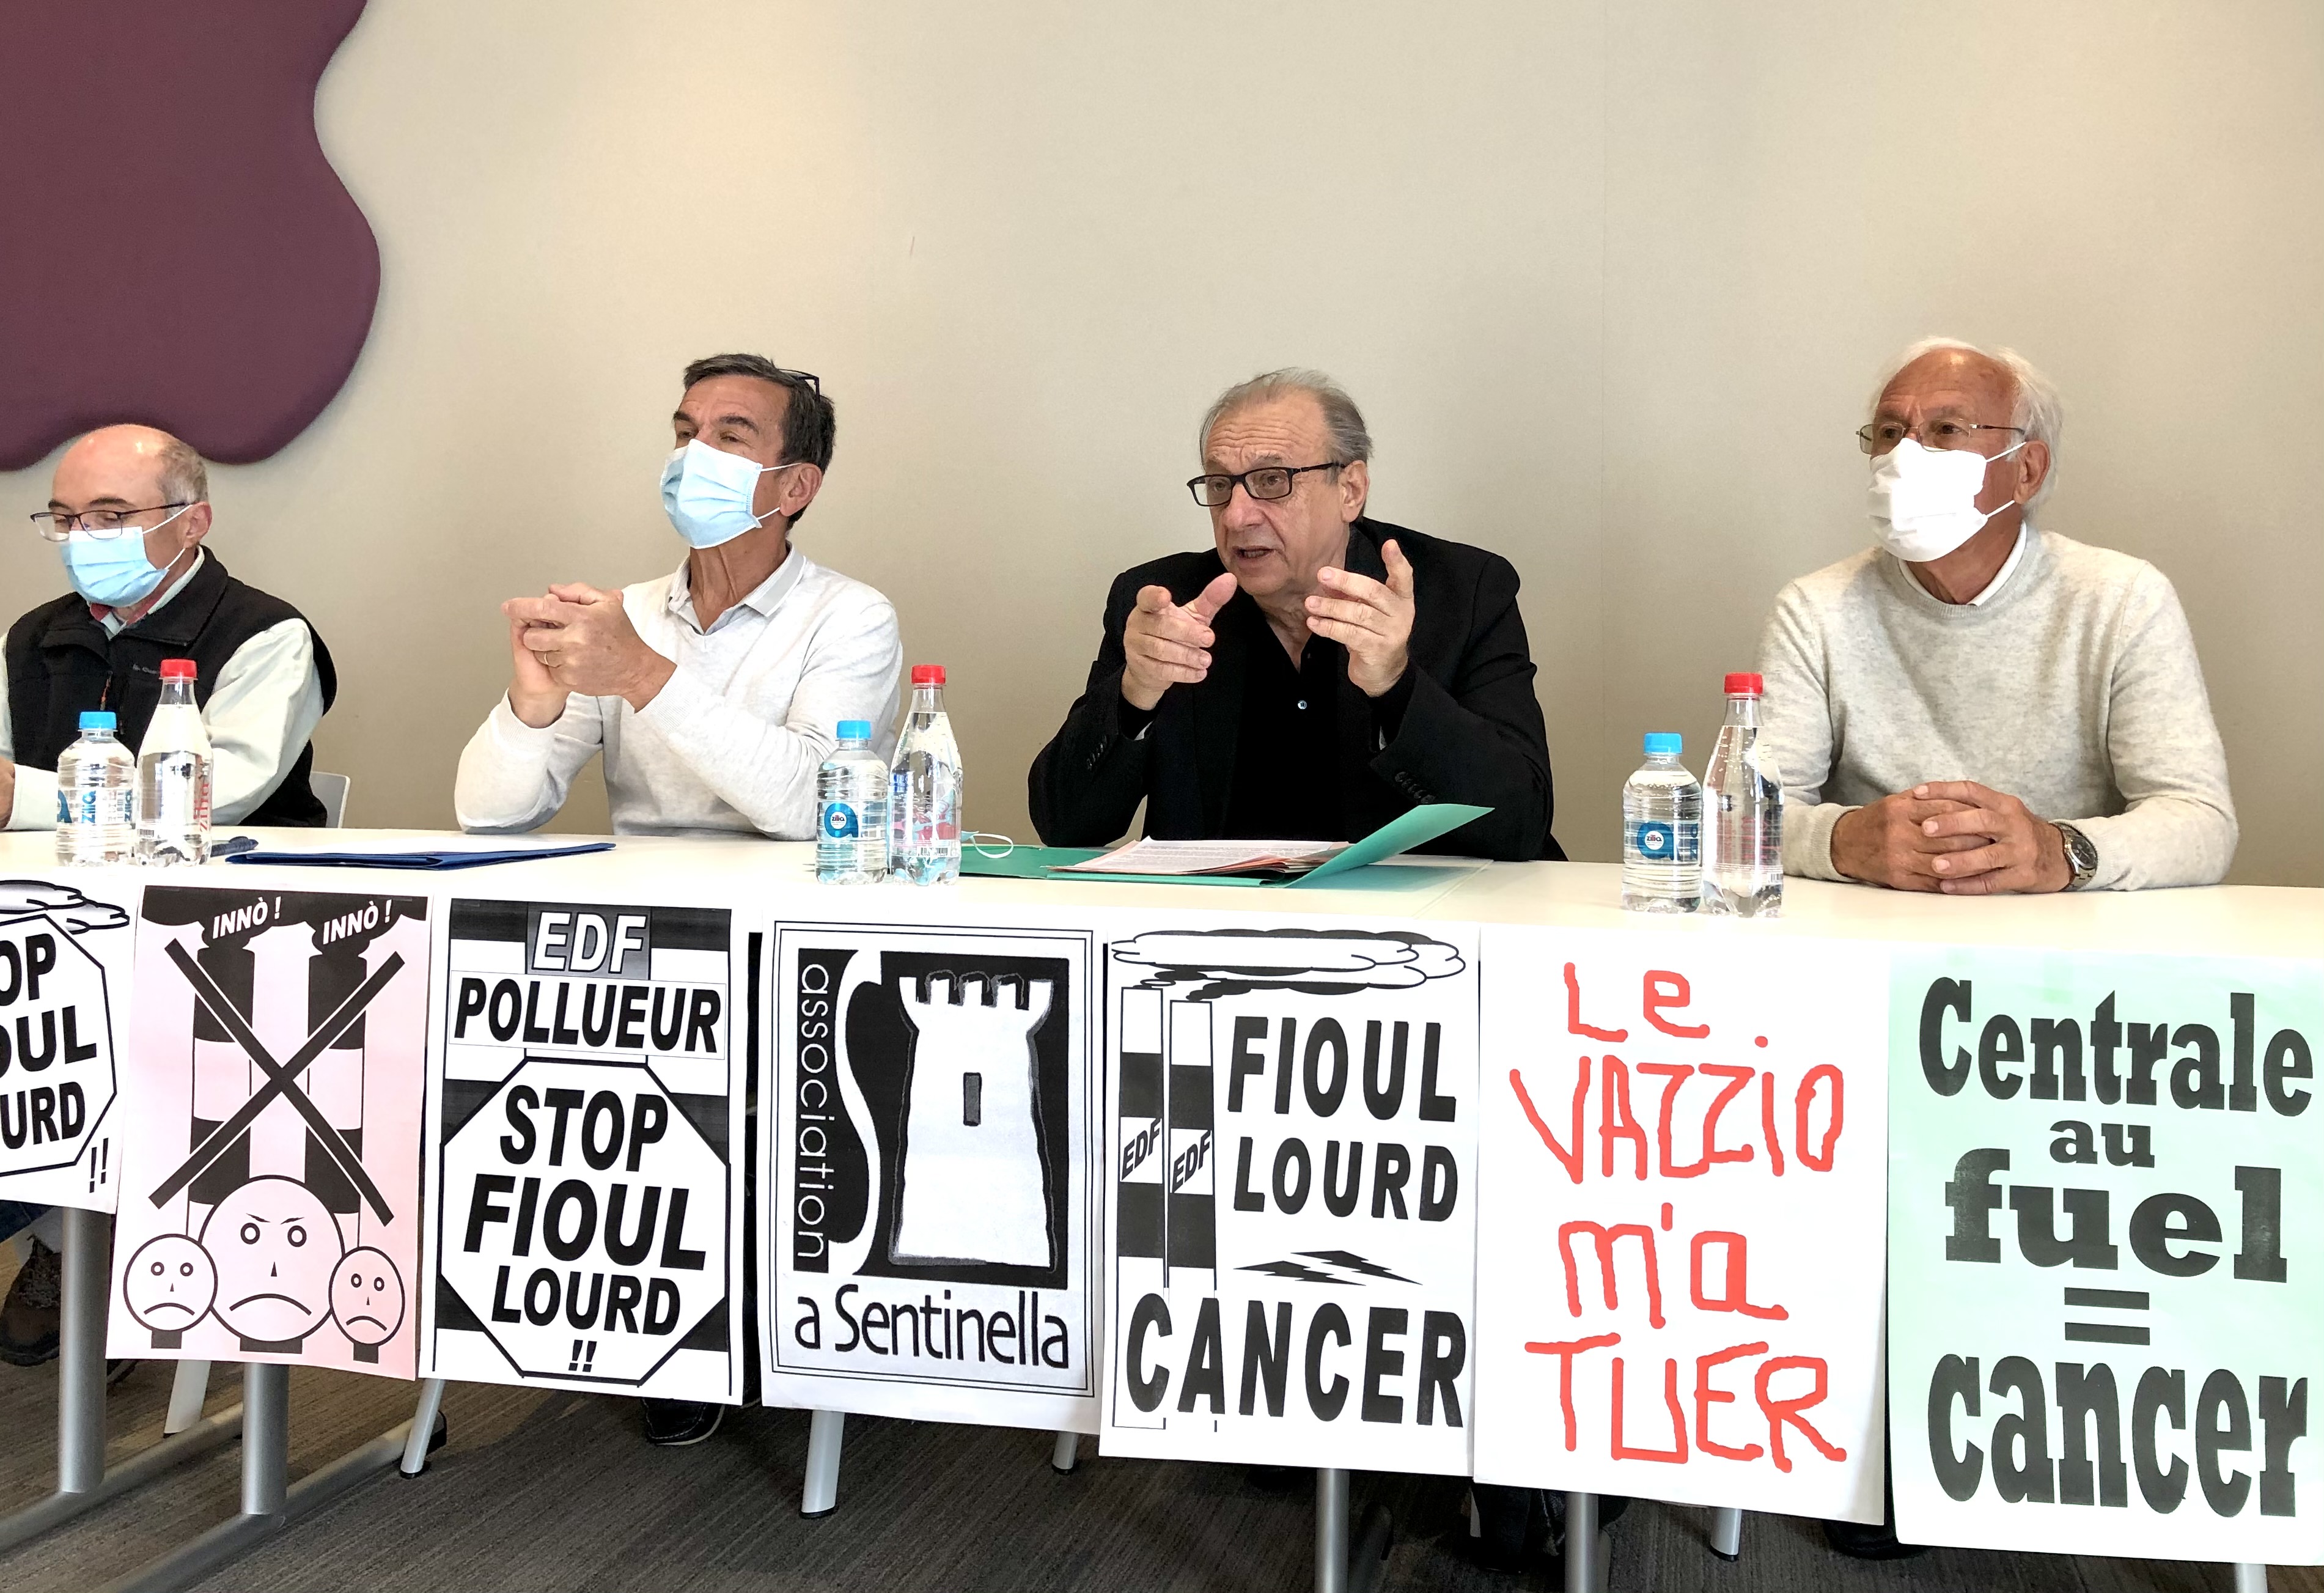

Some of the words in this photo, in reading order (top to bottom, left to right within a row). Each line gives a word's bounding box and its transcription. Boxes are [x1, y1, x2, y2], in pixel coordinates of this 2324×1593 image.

[213, 897, 268, 940] INNÒ
[323, 900, 379, 945] INNÒ
[532, 911, 648, 974] EDF
[0, 1006, 97, 1078] UL
[454, 977, 721, 1053] POLLUEUR
[1564, 962, 1710, 1043] Le
[1228, 1017, 1456, 1122] FIOUL
[1919, 976, 2313, 1117] Centrale
[500, 1085, 667, 1172] STOP
[798, 963, 835, 1259] association
[1122, 1117, 1161, 1180] EDF
[2049, 1119, 2155, 1168] au
[89, 1138, 109, 1193] !!
[1172, 1130, 1211, 1193] EDF
[1234, 1136, 1458, 1222] LOURD
[463, 1174, 706, 1271] FIOUL
[1945, 1148, 2287, 1283] fuel
[491, 1265, 680, 1336] LOURD
[795, 1295, 820, 1350] a
[835, 1284, 1069, 1369] Sentinella
[568, 1340, 597, 1372] !!
[1126, 1293, 1466, 1428] CANCER
[1524, 1333, 1847, 1473] TUER
[1928, 1353, 2308, 1518] cancer
